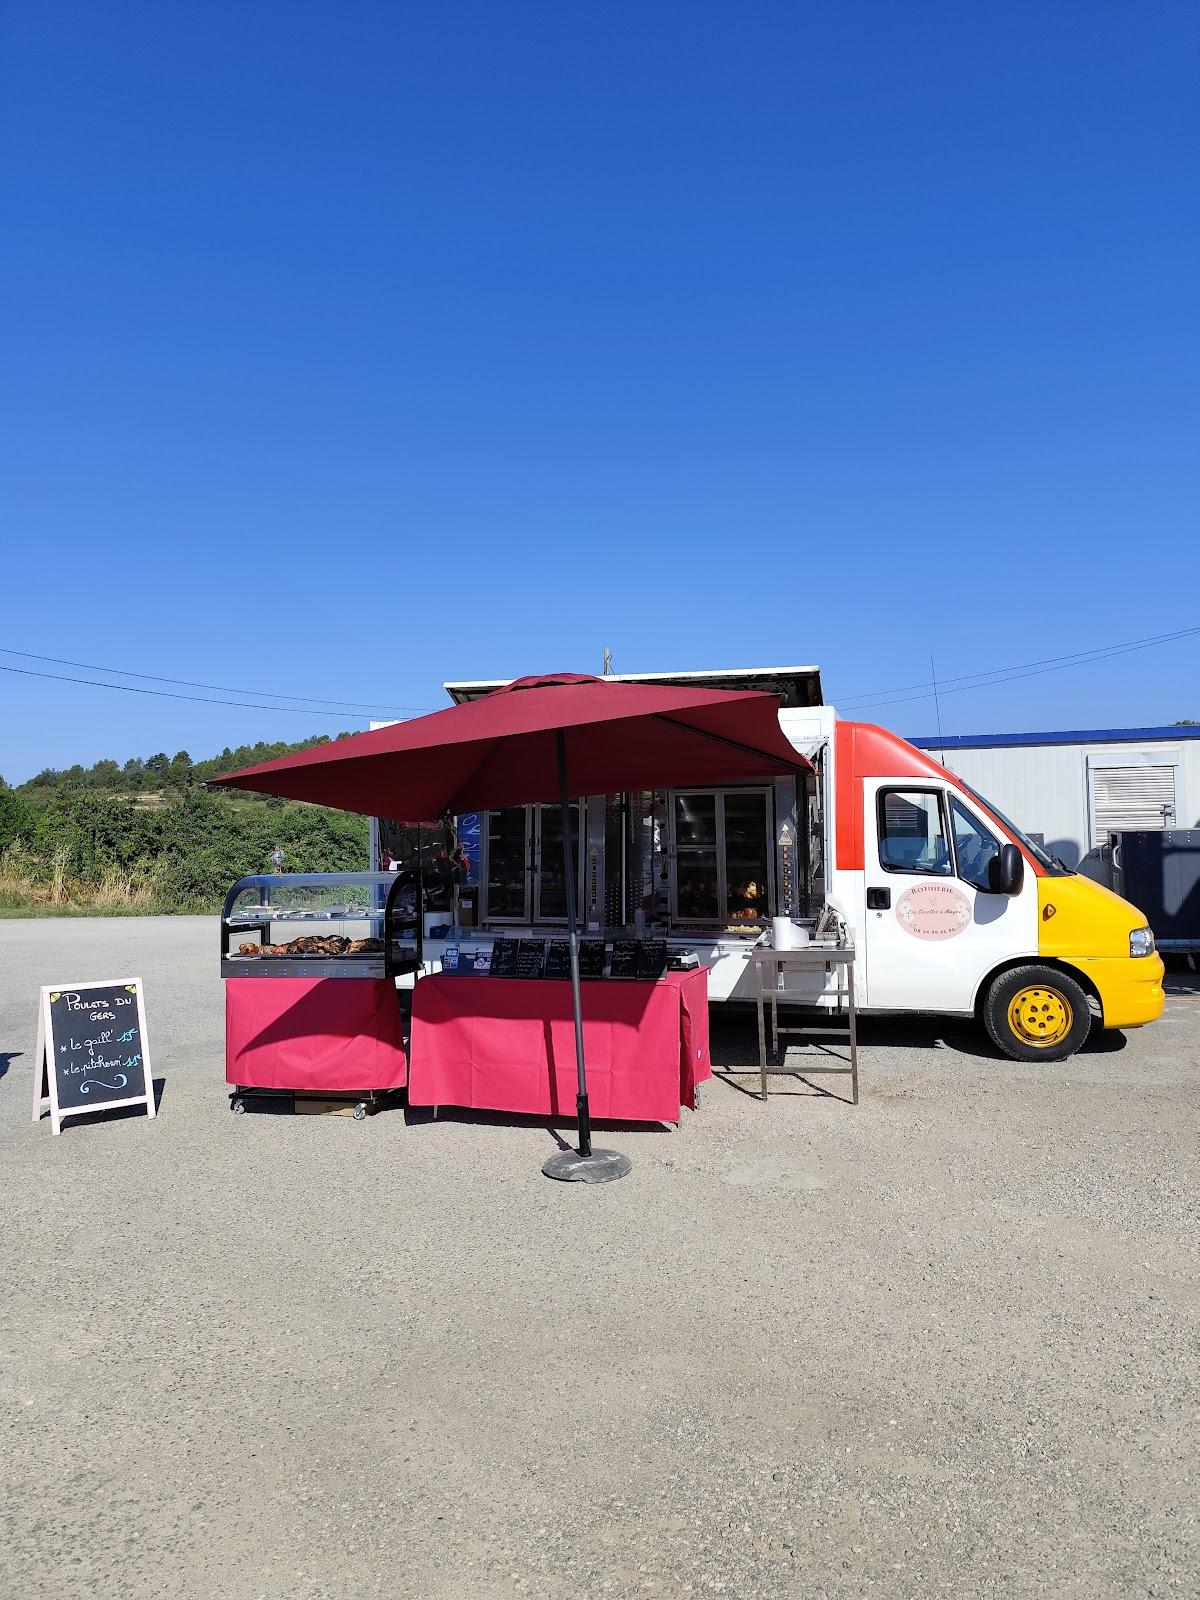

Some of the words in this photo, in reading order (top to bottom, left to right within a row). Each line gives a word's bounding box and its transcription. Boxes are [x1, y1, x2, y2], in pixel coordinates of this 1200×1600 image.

[911, 886, 953, 895] ROTISSERIE
[115, 997, 132, 1006] DU
[89, 1011, 116, 1022] GERS
